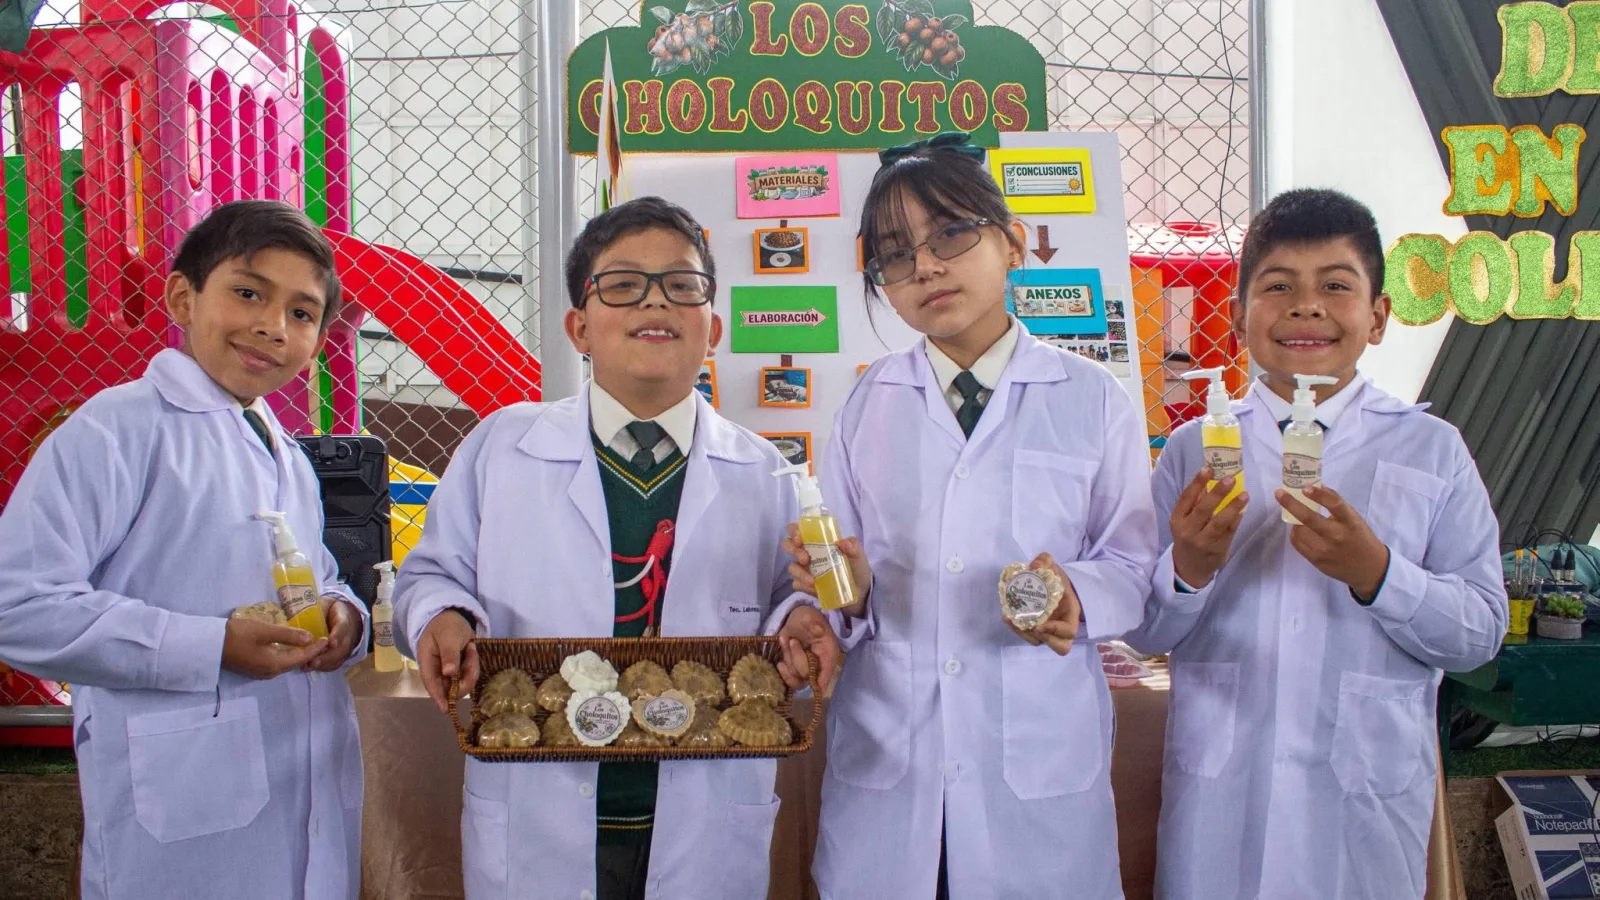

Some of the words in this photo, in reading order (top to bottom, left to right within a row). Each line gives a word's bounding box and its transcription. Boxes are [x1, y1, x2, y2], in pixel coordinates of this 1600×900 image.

[748, 1, 872, 58] LOS
[578, 77, 1030, 134] CHOLOQUITOS
[1016, 166, 1078, 177] CONCLUSIONES
[1441, 123, 1586, 218] EN
[758, 175, 819, 189] MATERIALES
[1025, 288, 1082, 301] ANEXOS
[748, 311, 819, 323] ELABORACIÓN
[1535, 820, 1588, 832] Notepad
